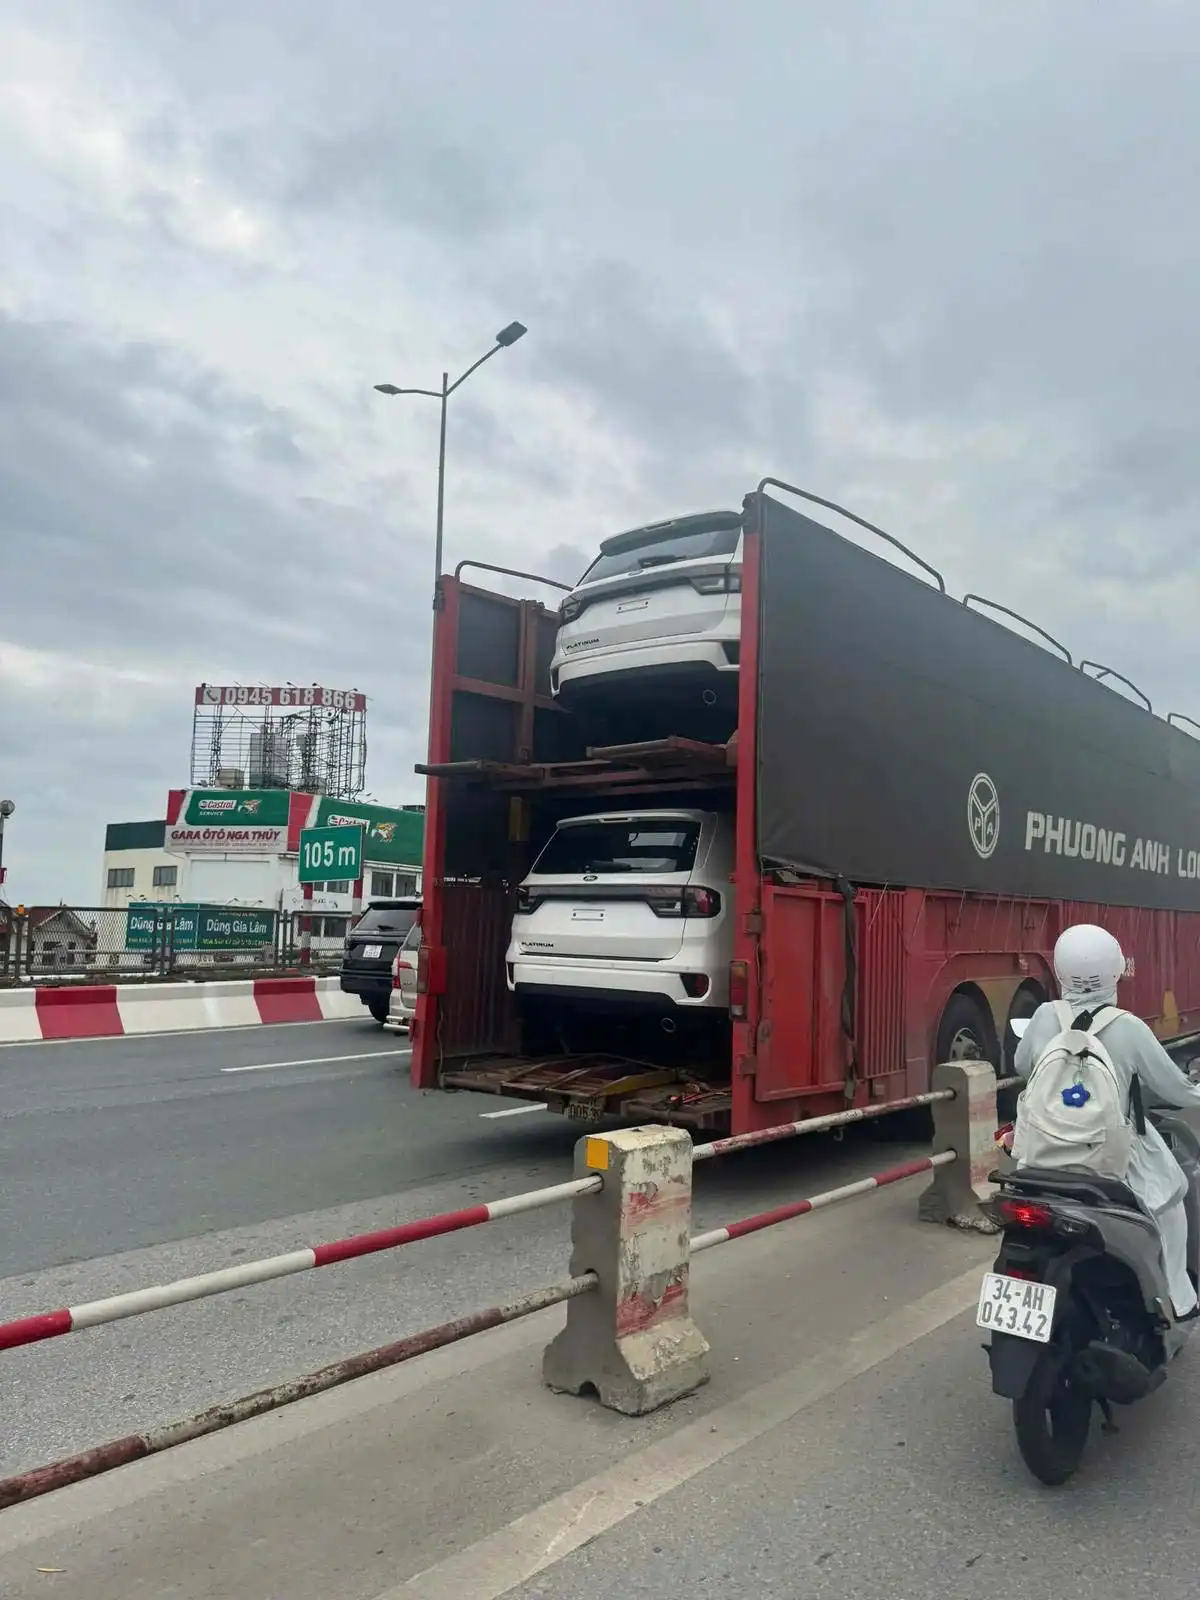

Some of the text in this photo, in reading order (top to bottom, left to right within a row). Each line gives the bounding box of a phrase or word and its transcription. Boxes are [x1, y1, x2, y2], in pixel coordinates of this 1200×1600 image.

[224, 687, 356, 709] 0945 618 866
[207, 800, 234, 809] Castrol
[171, 830, 201, 840] GARA
[226, 830, 250, 840] NGA
[1024, 810, 1127, 867] PHUONG
[1129, 837, 1170, 875] ANH
[304, 841, 356, 869] 105 m
[174, 917, 194, 931] Lâm
[232, 920, 248, 933] Gia
[249, 921, 267, 934] Lâm
[992, 1279, 1045, 1311] 34-AH
[981, 1301, 1048, 1338] 043.42
